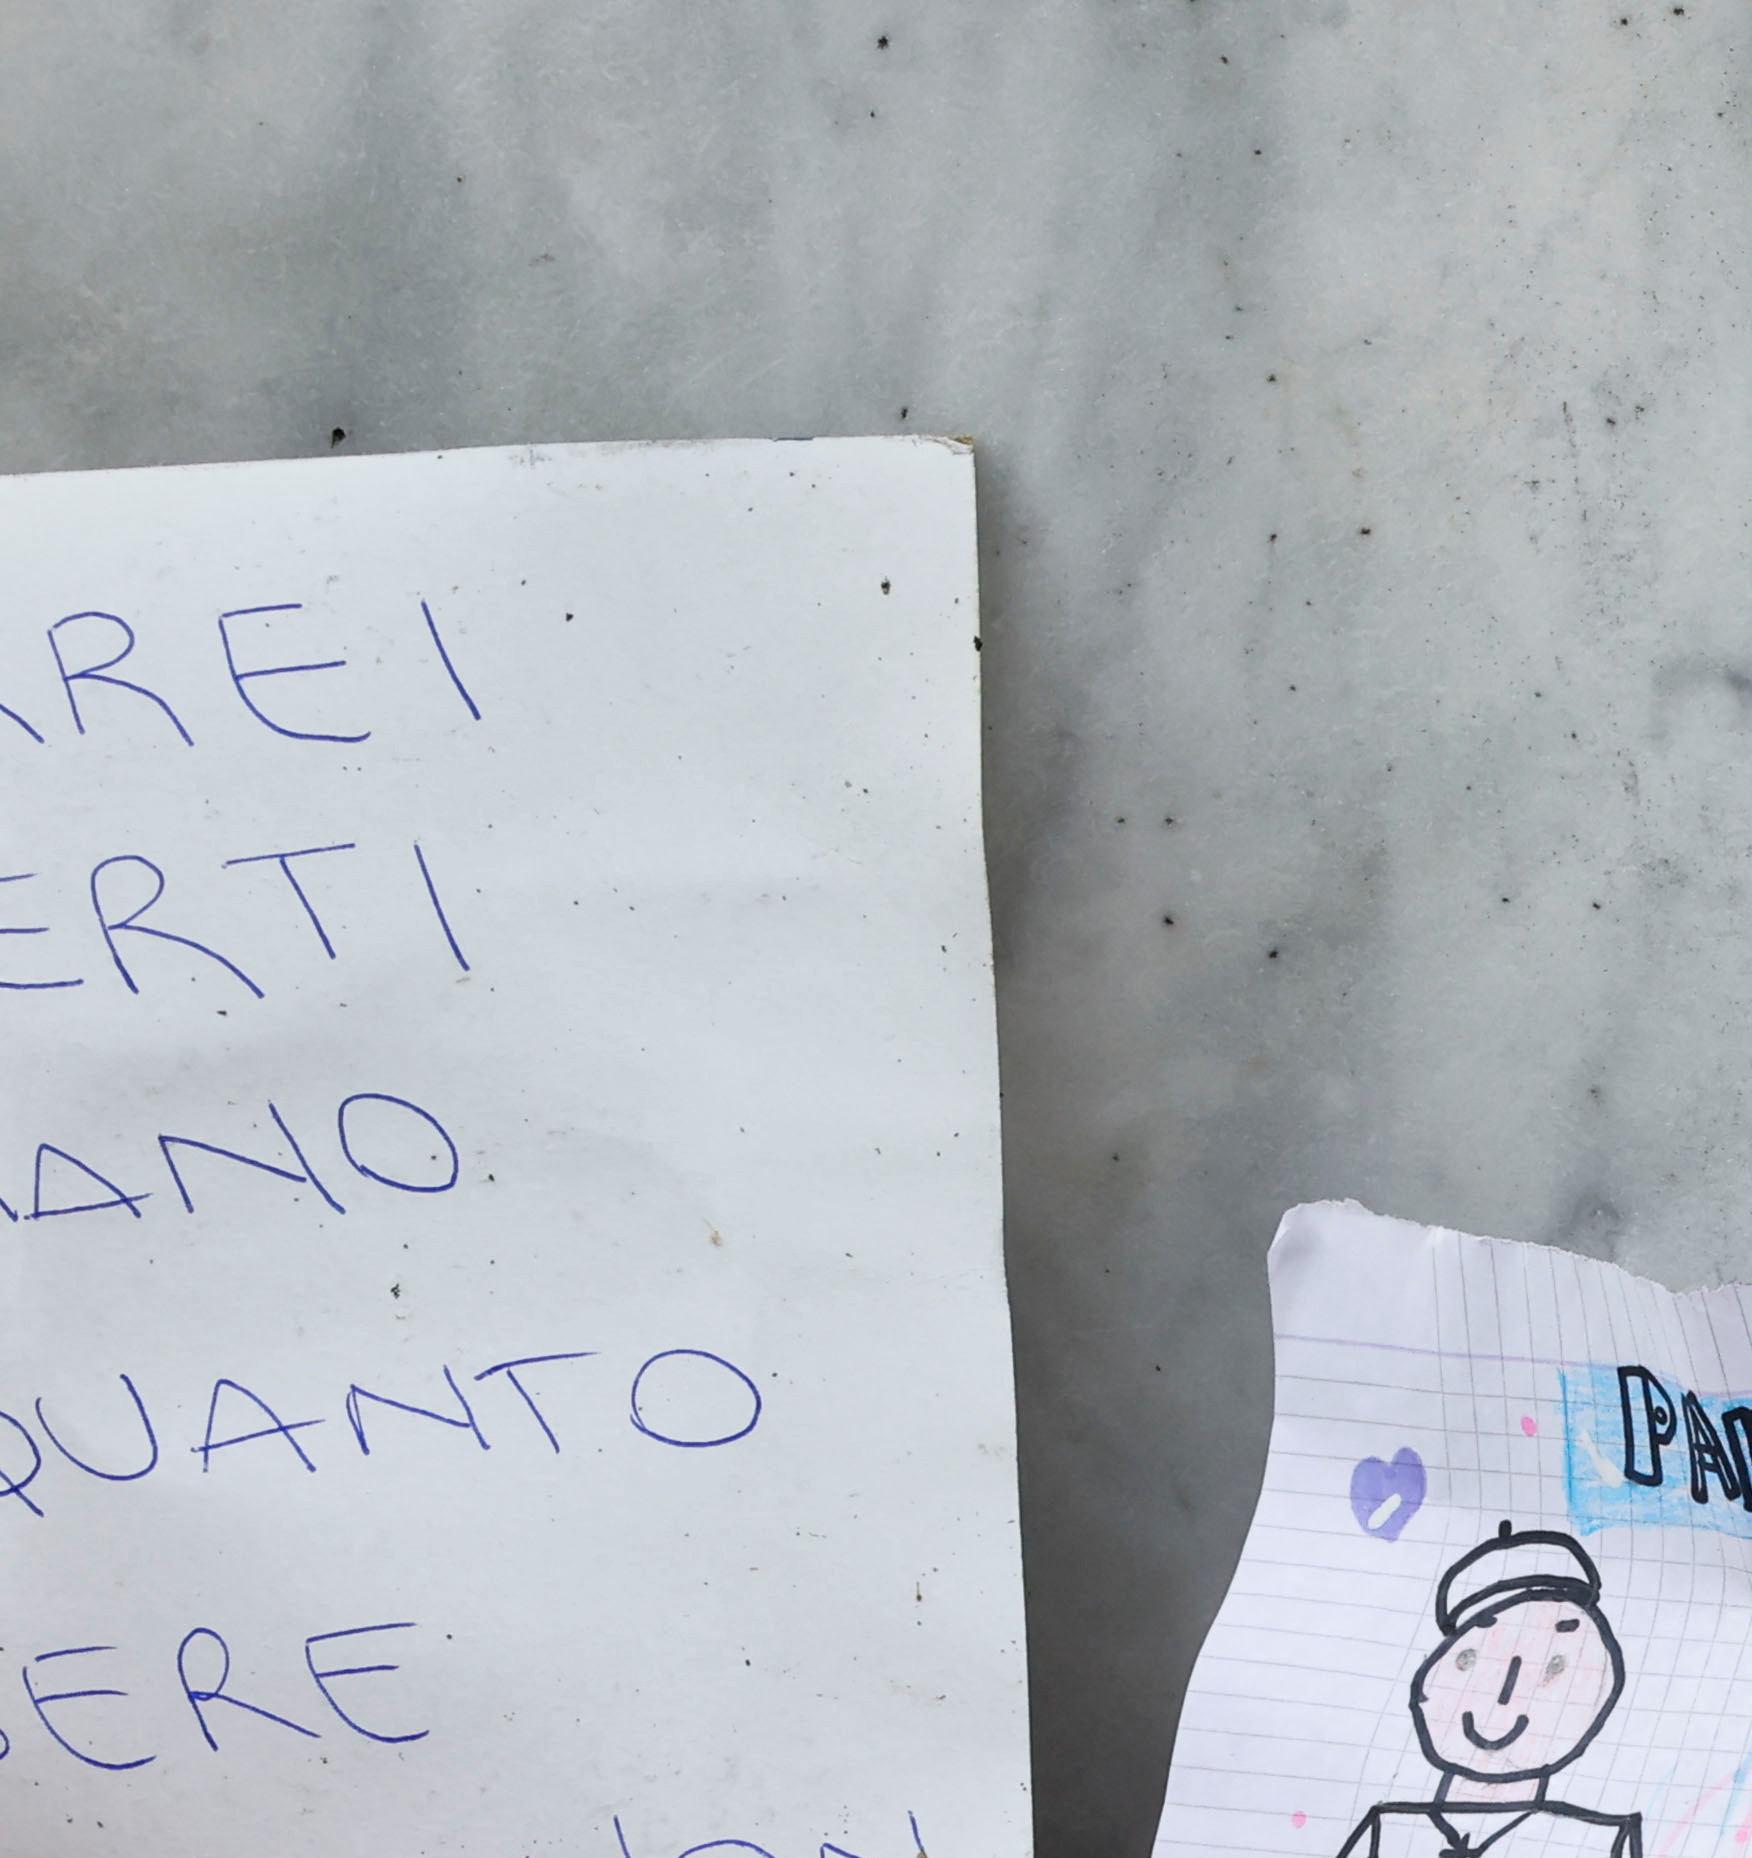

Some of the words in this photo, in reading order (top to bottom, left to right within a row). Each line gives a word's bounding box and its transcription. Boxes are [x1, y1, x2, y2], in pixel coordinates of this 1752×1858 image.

[0, 600, 481, 746] REI
[0, 1094, 458, 1221] ANO
[0, 1622, 431, 1770] ERE
